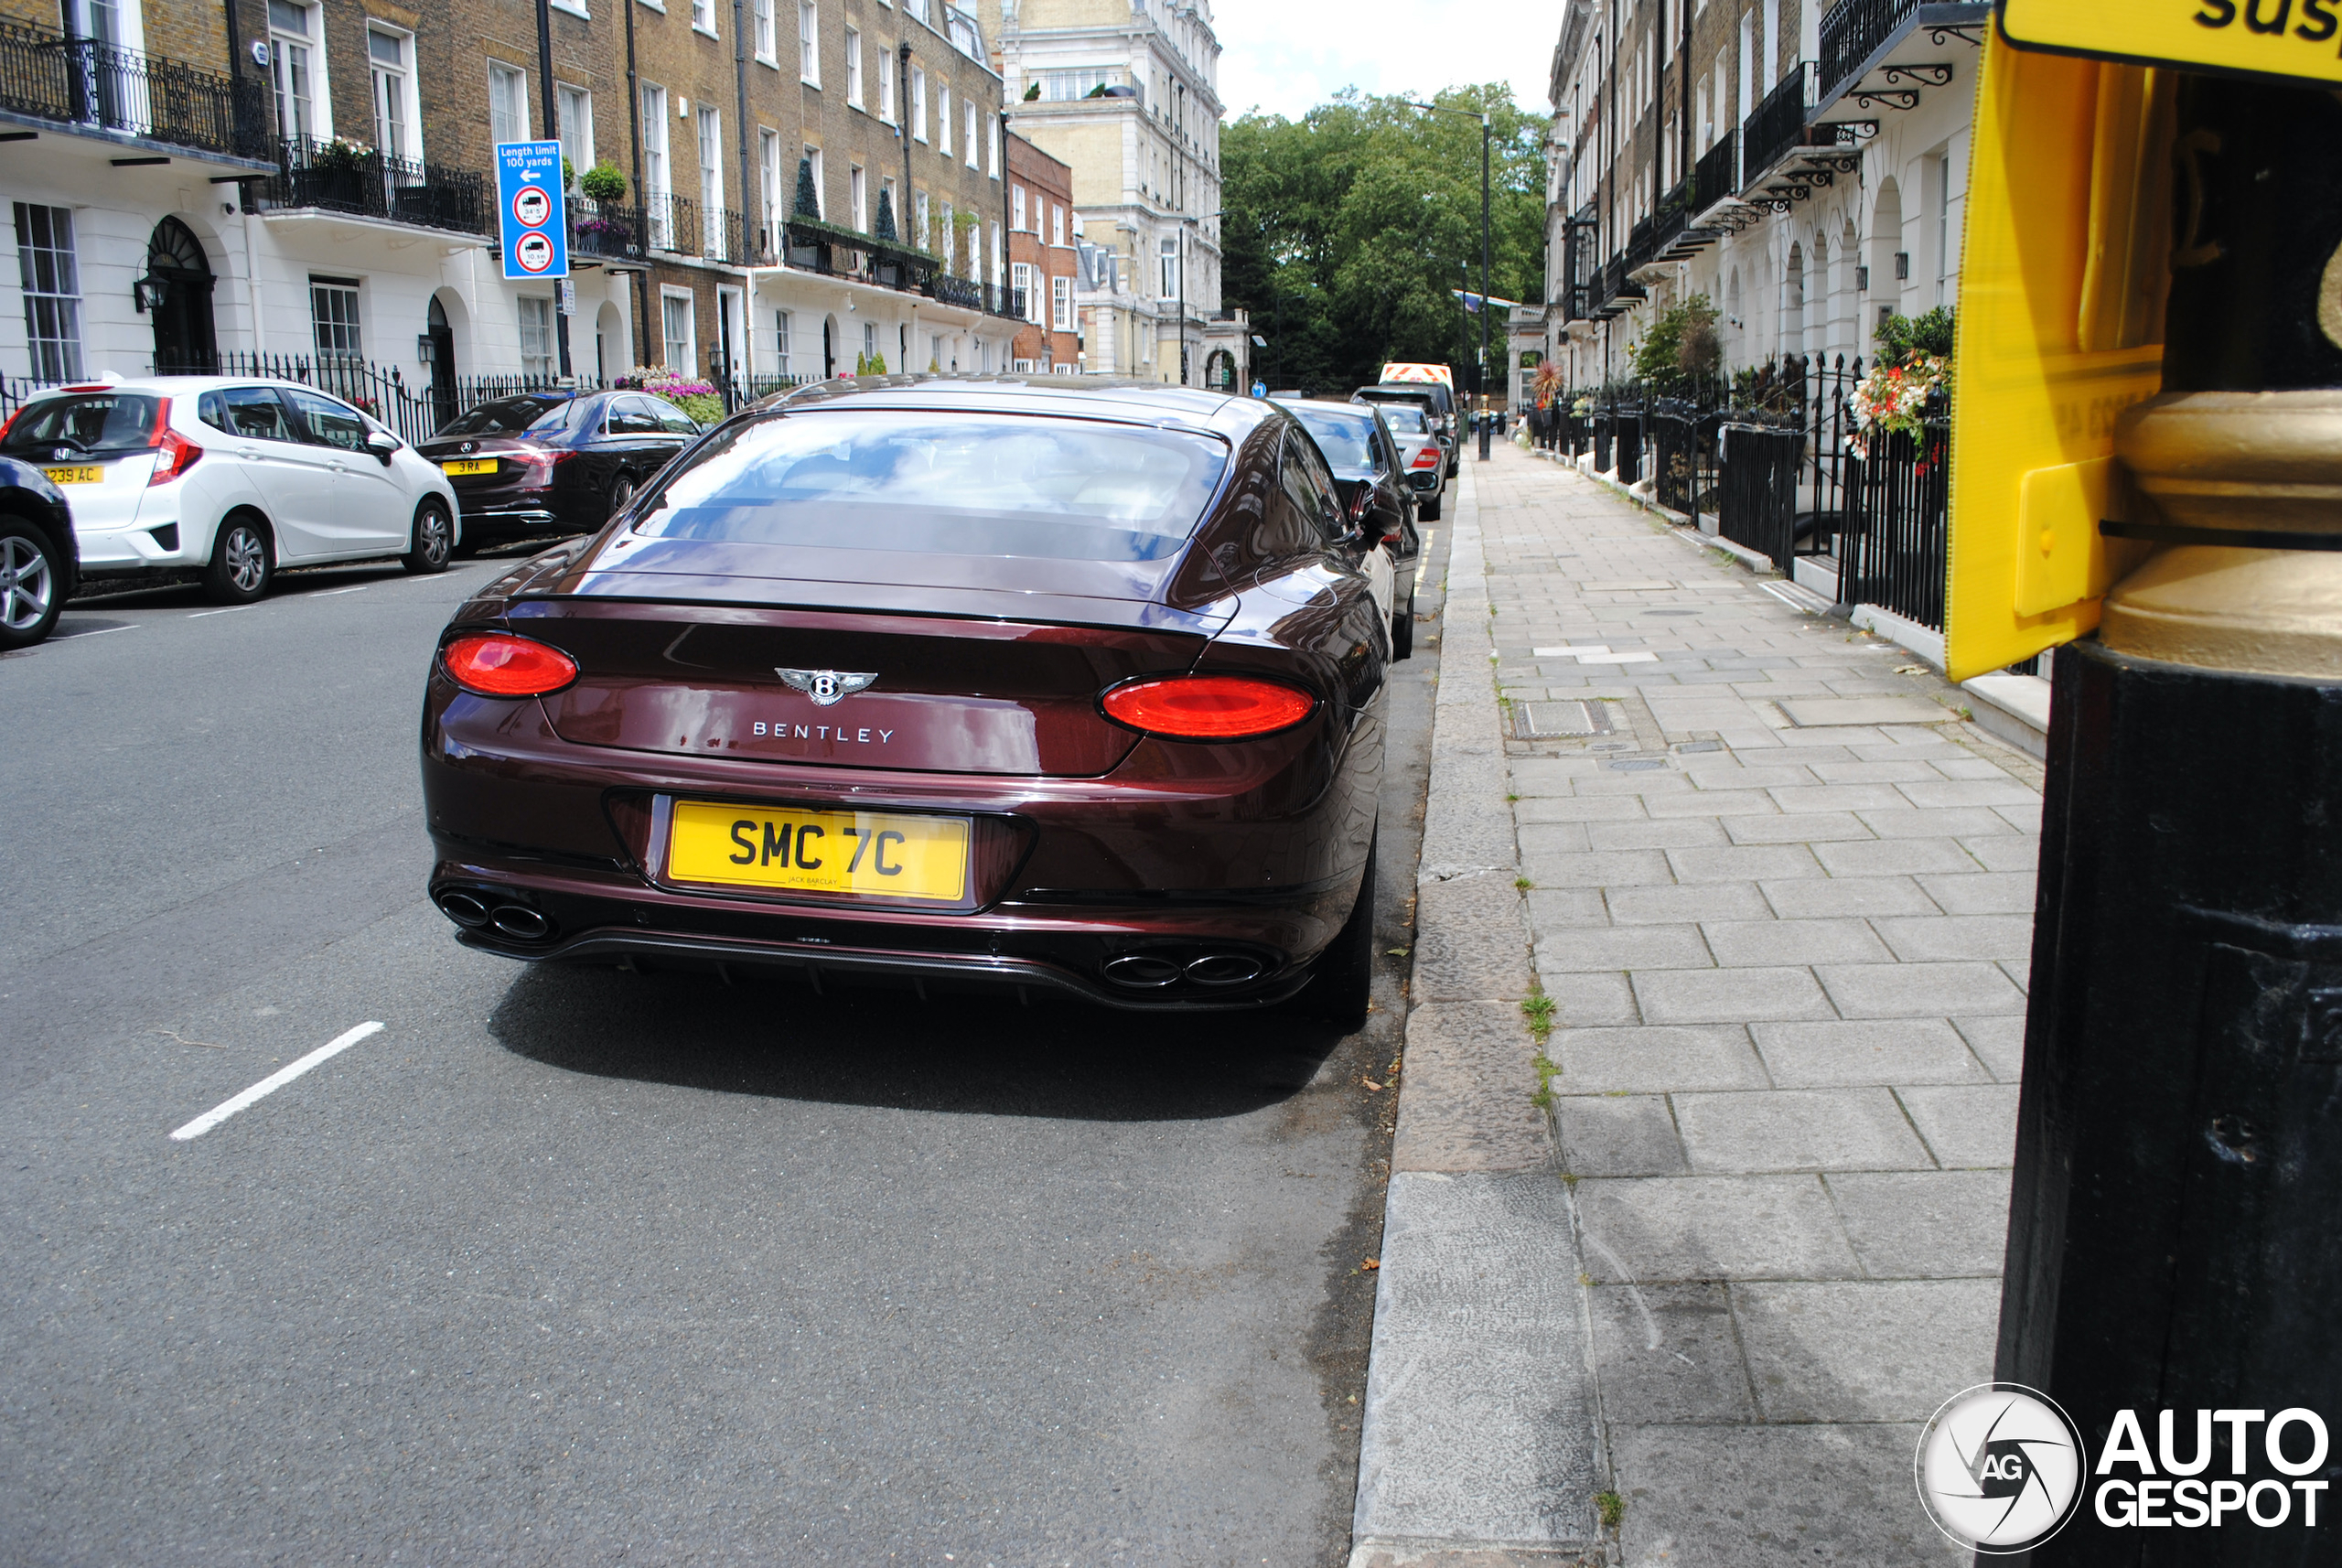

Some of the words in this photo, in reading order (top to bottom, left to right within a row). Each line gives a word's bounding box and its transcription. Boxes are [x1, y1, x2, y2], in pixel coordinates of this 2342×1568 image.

[2193, 0, 2342, 59] sus
[501, 146, 533, 157] Length
[535, 145, 556, 155] limit
[507, 157, 524, 166] 100
[527, 156, 553, 168] yards
[459, 462, 466, 472] 3
[467, 462, 480, 472] RA
[79, 467, 94, 481] AC
[753, 722, 894, 744] BENTLEY
[729, 820, 825, 870] SMC
[843, 827, 905, 875] 7C
[806, 877, 837, 886] BARCLAY
